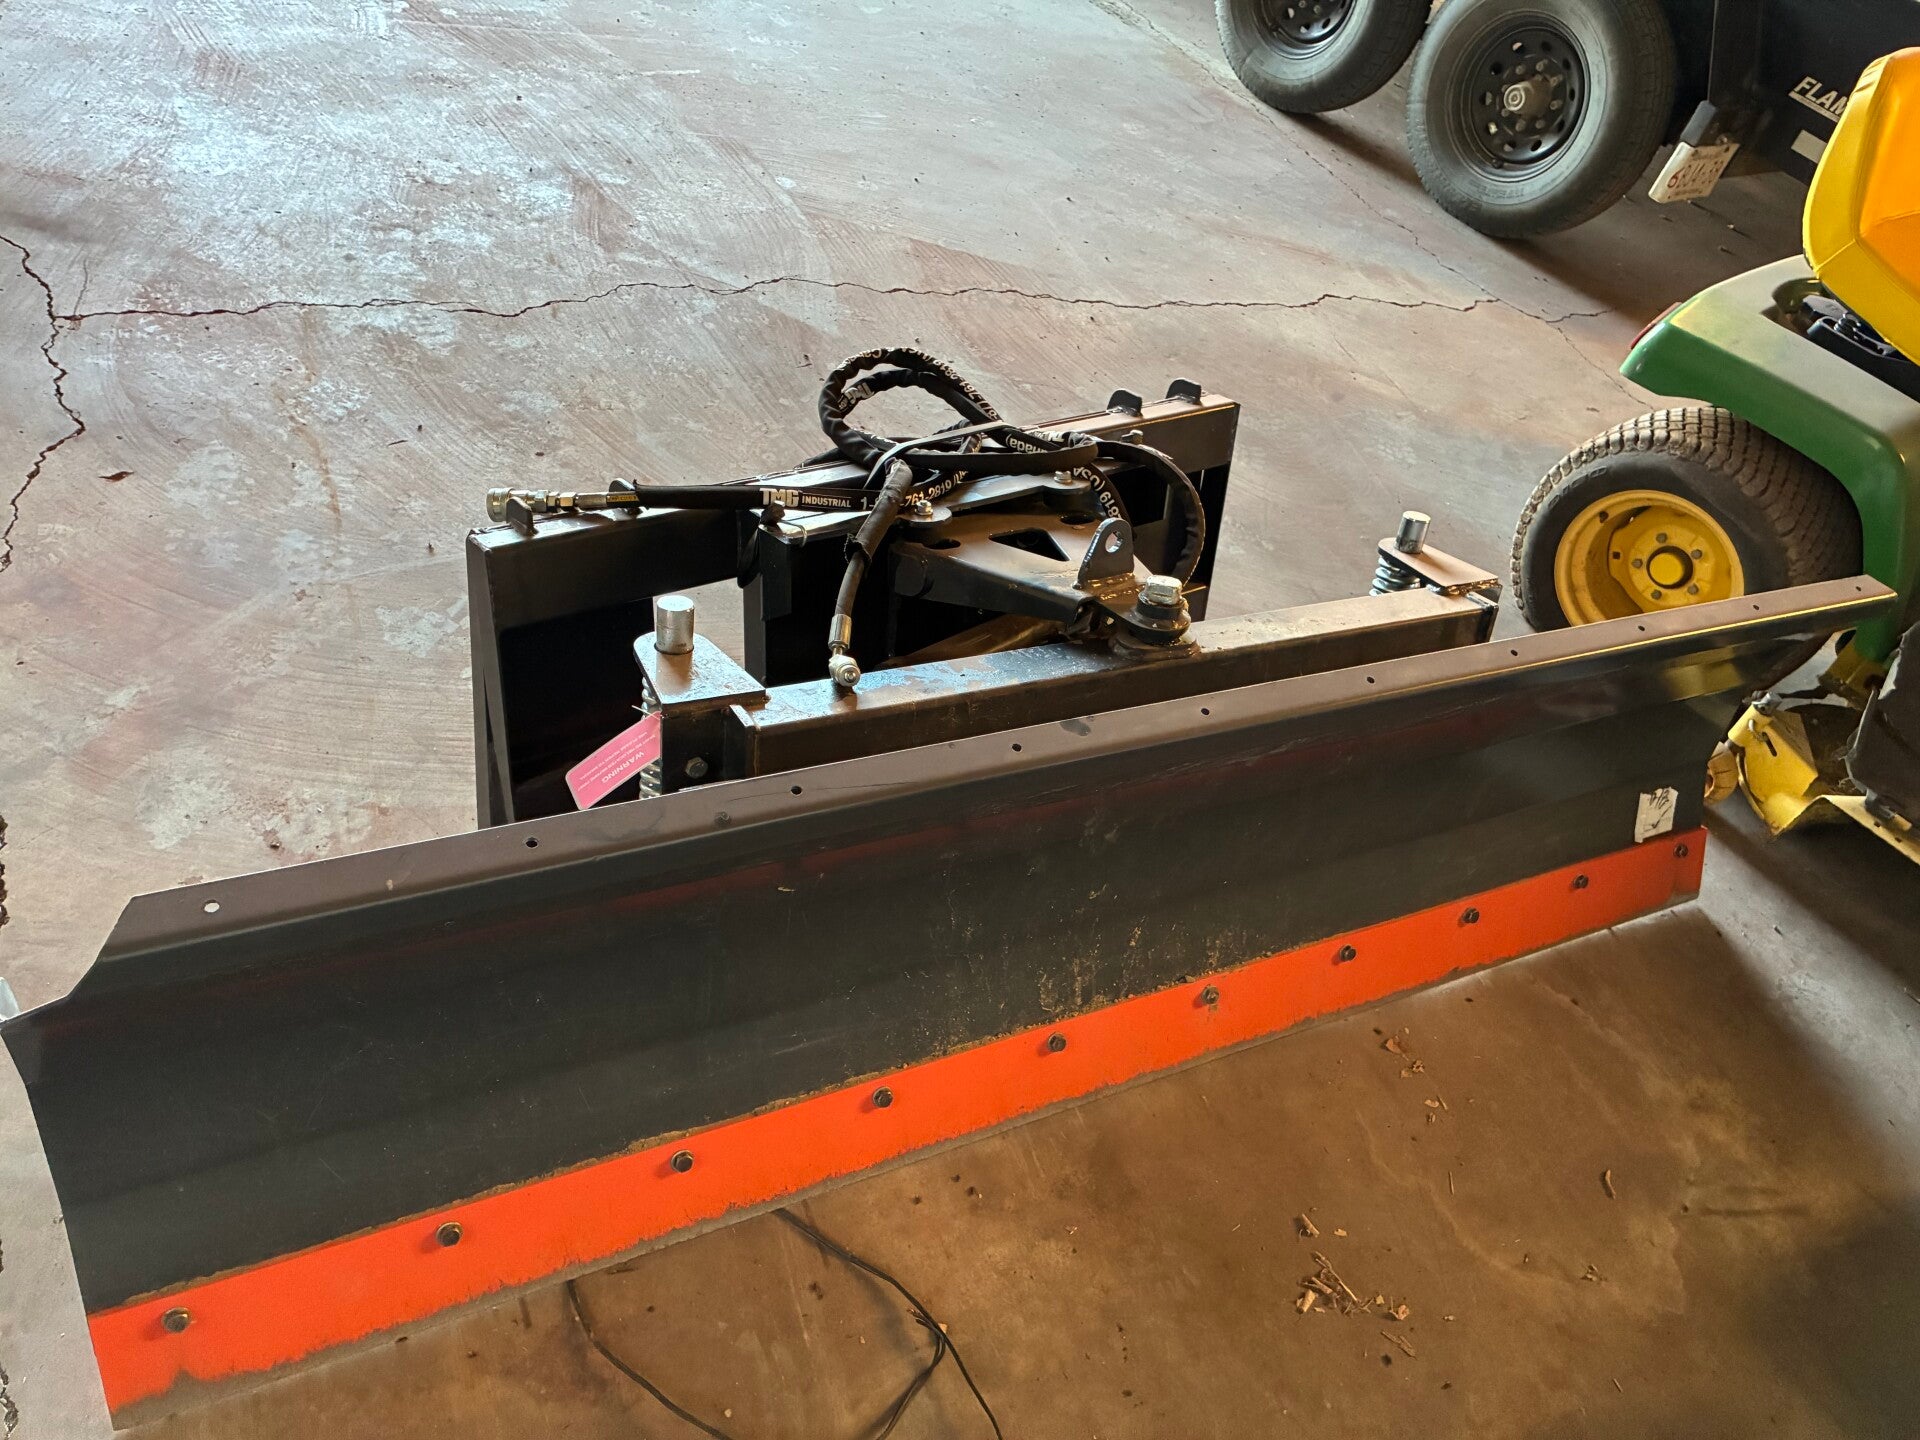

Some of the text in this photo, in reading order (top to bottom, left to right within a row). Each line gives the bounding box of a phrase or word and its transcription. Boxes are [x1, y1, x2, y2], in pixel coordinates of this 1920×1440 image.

[1794, 76, 1850, 115] FLAM
[760, 488, 800, 508] TMG
[802, 495, 852, 509] INDUSTRIAL
[600, 750, 645, 783] WARNING
